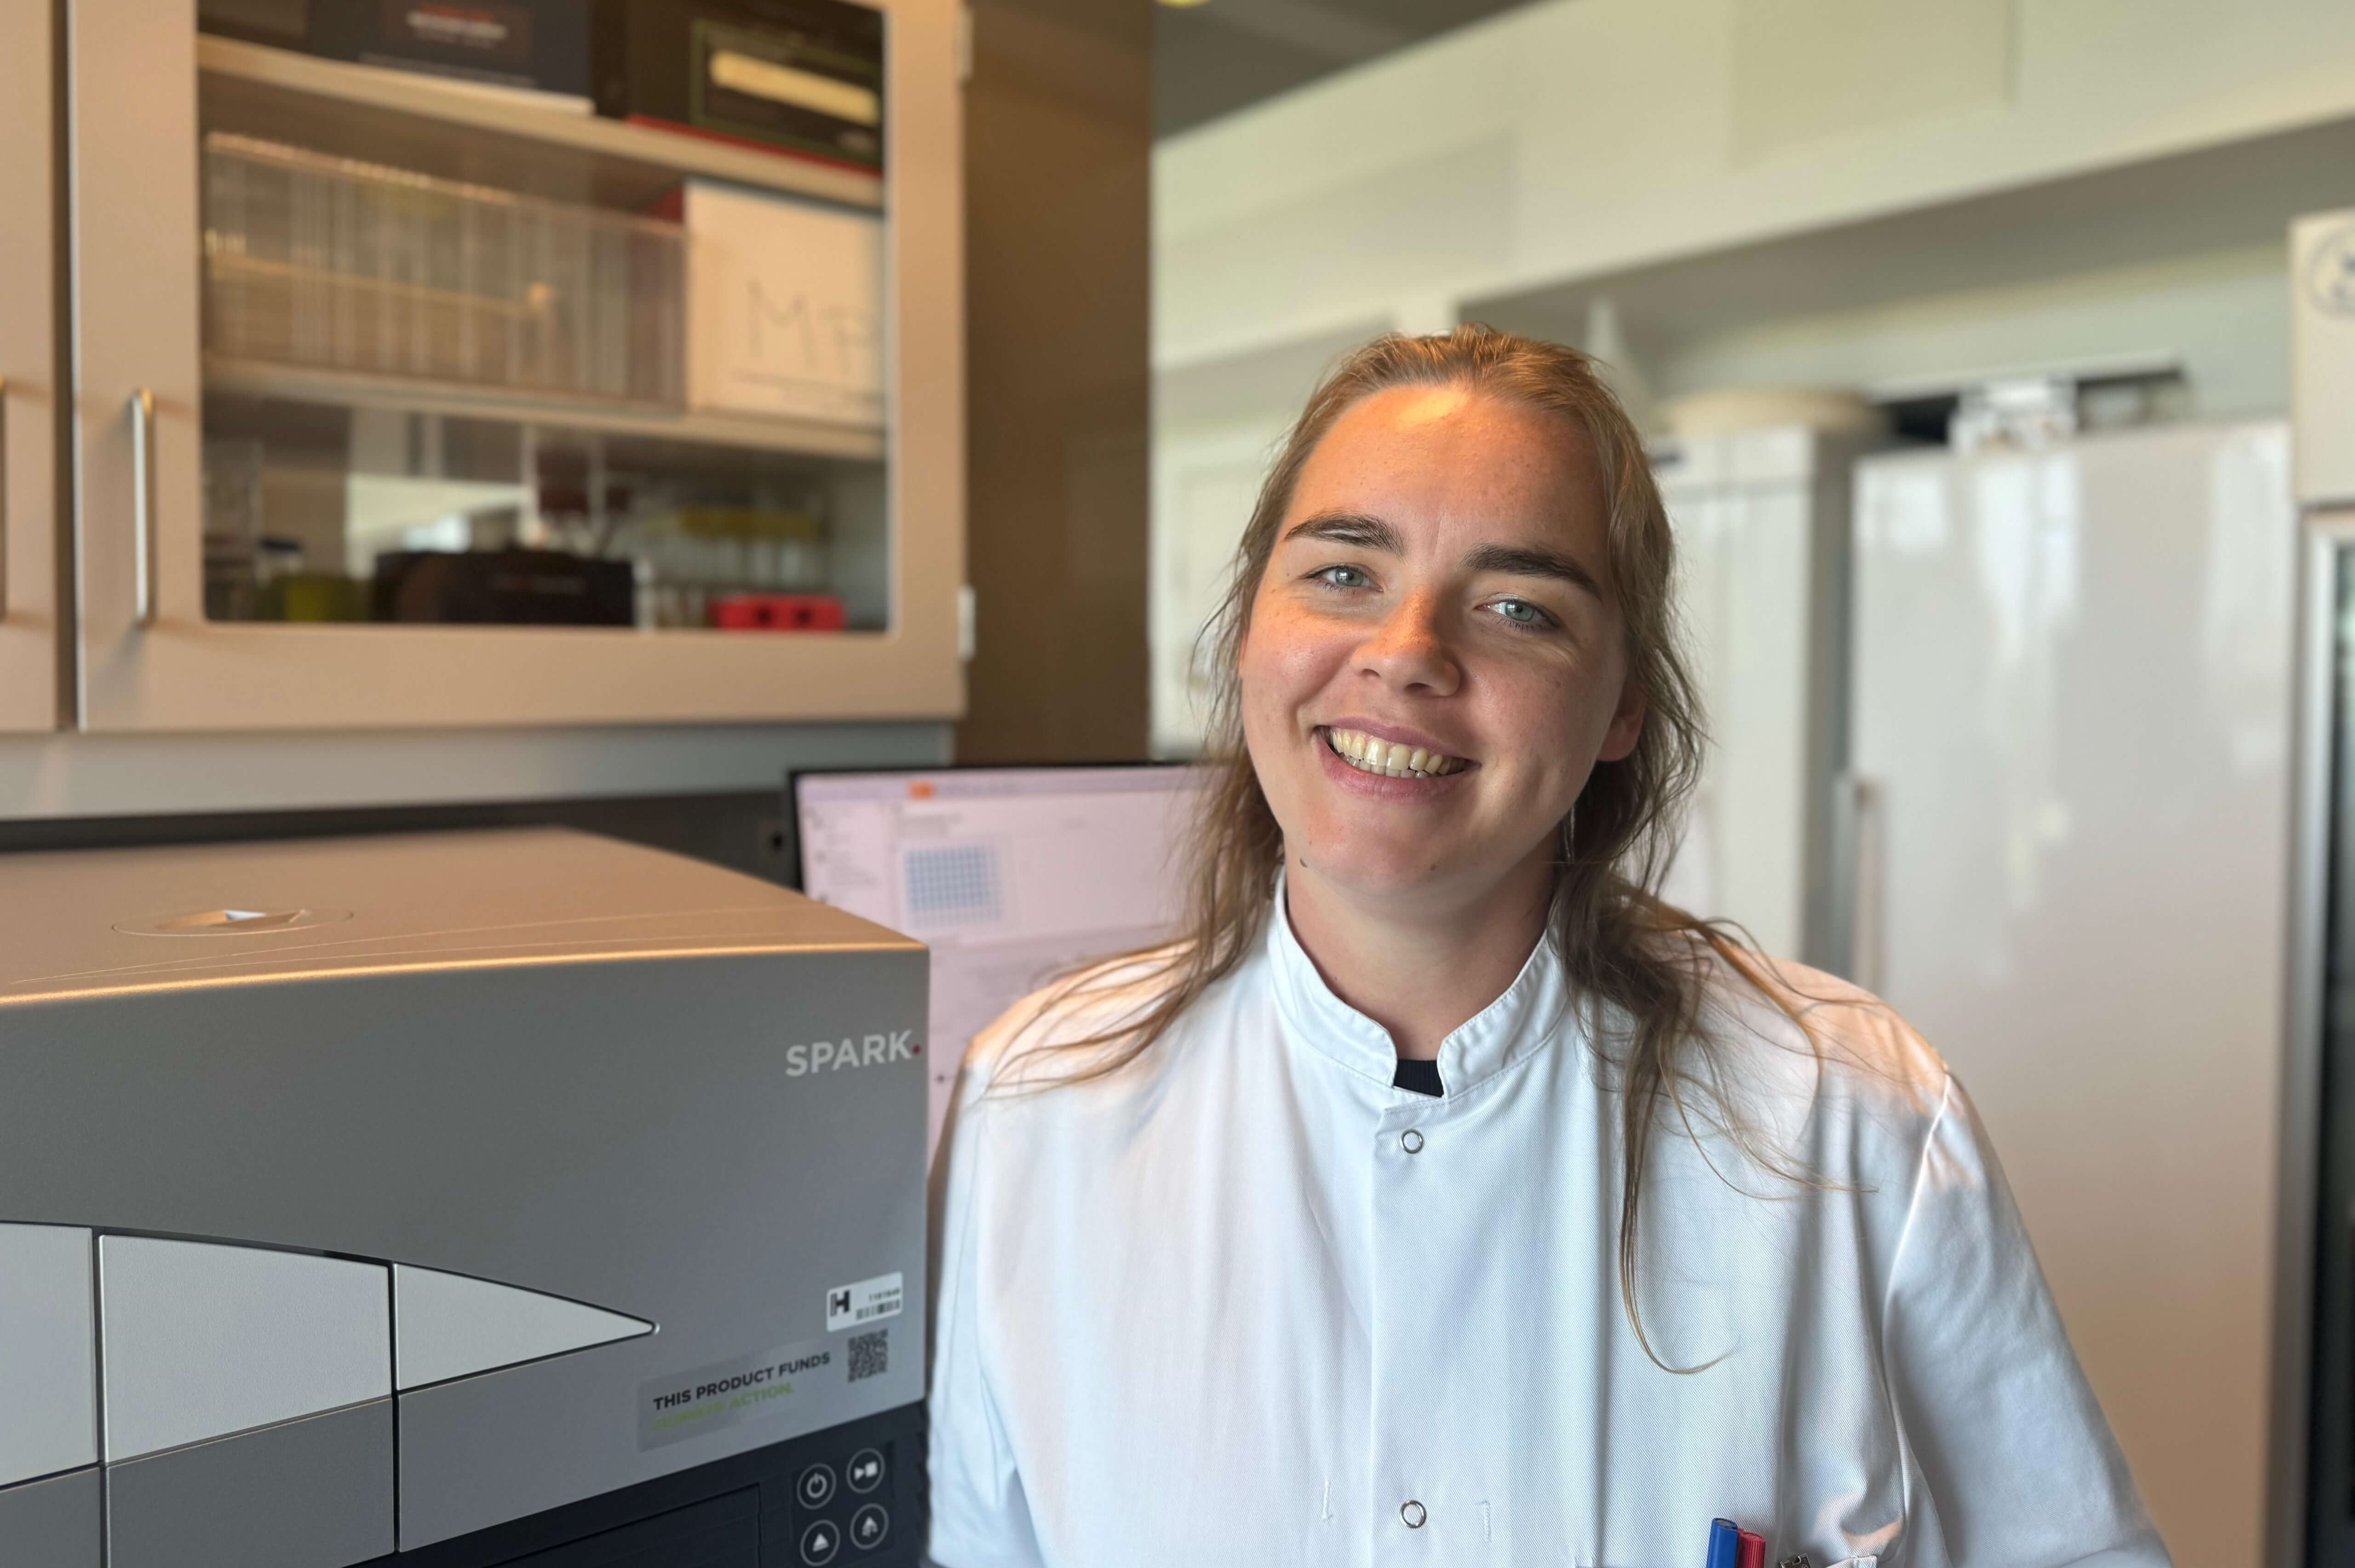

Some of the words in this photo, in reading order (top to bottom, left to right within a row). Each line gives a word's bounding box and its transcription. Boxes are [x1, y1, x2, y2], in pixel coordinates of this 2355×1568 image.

[653, 1390, 691, 1411] THIS
[696, 1366, 774, 1400] PRODUCT
[778, 1351, 831, 1377] FUNDS
